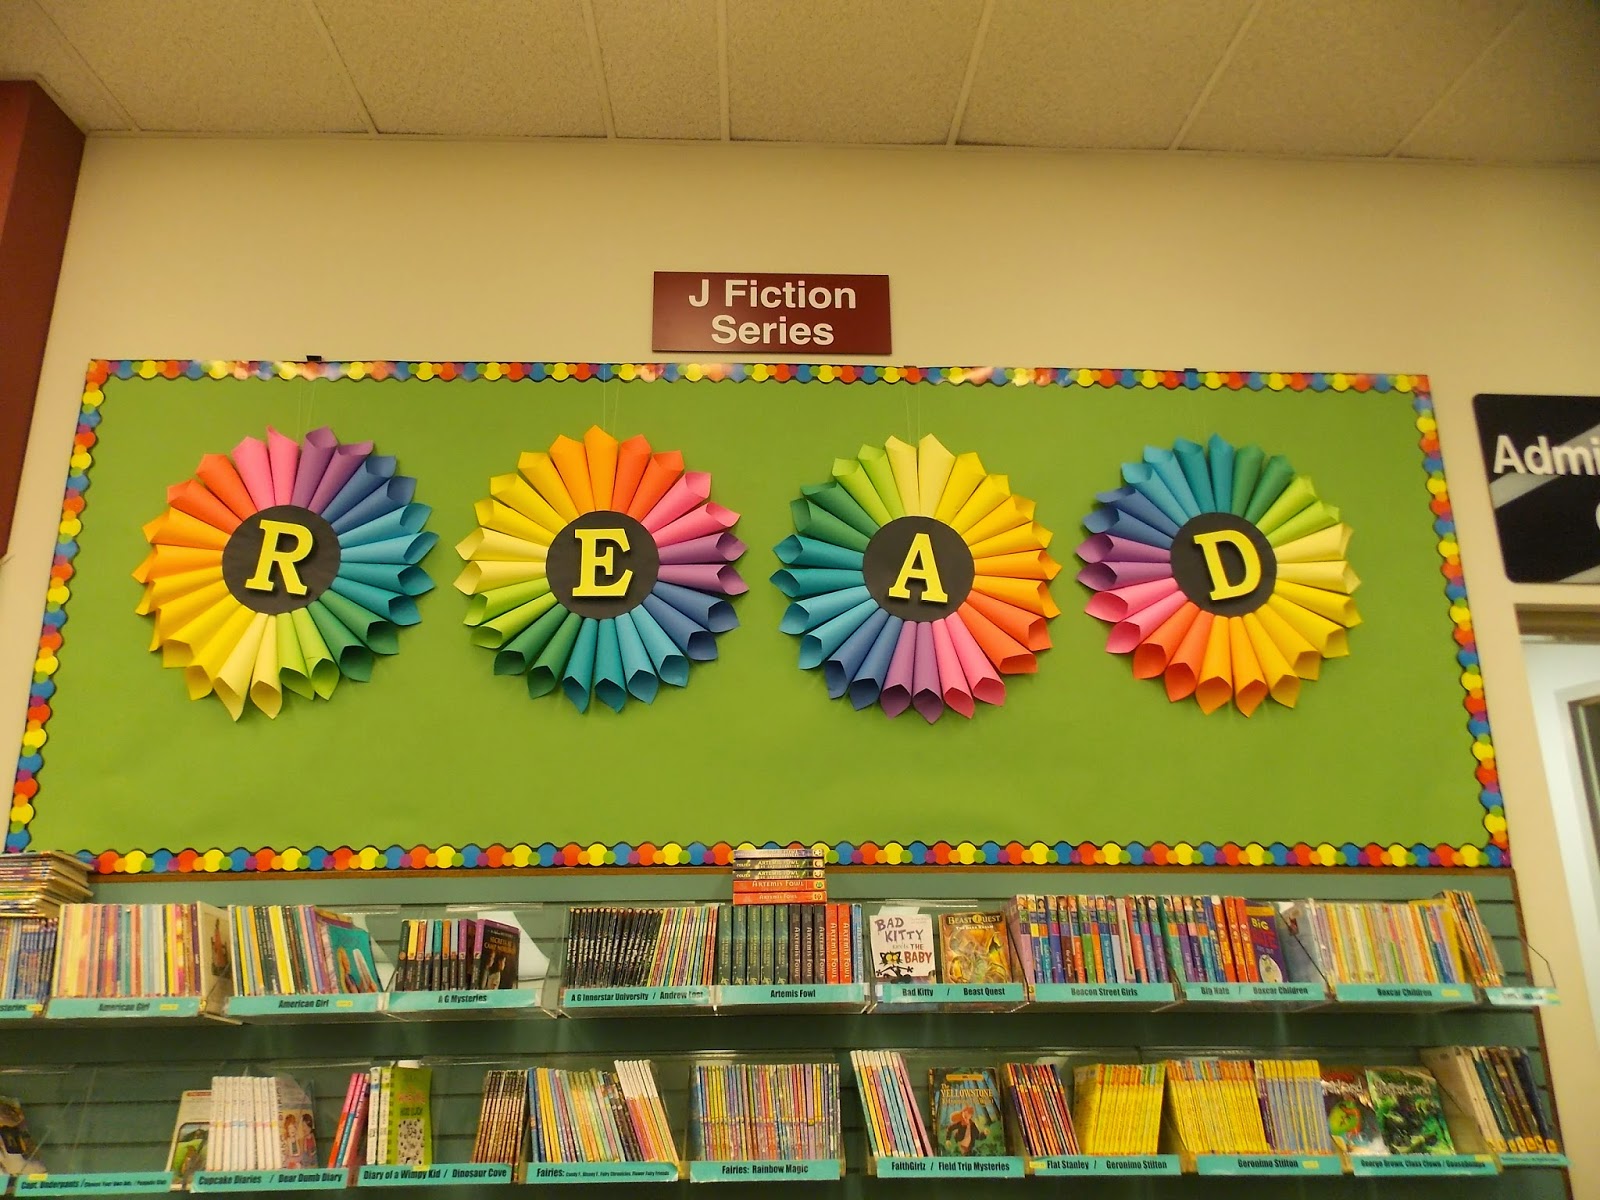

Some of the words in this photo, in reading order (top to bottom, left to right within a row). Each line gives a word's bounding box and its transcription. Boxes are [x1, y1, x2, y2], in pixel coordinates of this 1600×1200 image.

[689, 279, 710, 307] J
[725, 279, 857, 309] Fiction
[711, 314, 834, 345] Series
[1493, 435, 1600, 476] Admi
[245, 519, 314, 597] R
[572, 528, 634, 597] E
[888, 533, 948, 603] A
[1194, 529, 1262, 601] D
[875, 917, 904, 932] BAD
[885, 929, 924, 943] KITTY
[904, 951, 932, 964] BABY
[571, 993, 576, 1002] A
[583, 992, 614, 1001] Innerstar
[614, 991, 649, 1001] University
[660, 990, 687, 999] Andrew
[770, 989, 798, 998] Artemis
[799, 989, 816, 998] Fowl
[902, 988, 916, 997] Bad
[917, 987, 934, 997] Kitty
[963, 987, 983, 996] Beast
[984, 987, 1006, 996] Quest
[1071, 988, 1098, 997] Beacon
[1099, 988, 1120, 996] Street
[1121, 988, 1138, 997] Girls
[1200, 986, 1213, 995] Big
[1278, 986, 1308, 995] Children
[1377, 988, 1401, 997] Boxcar
[1402, 988, 1432, 997] Children
[278, 1000, 314, 1009] American
[315, 999, 329, 1008] Girl
[444, 995, 450, 1003] G
[451, 993, 487, 1004] Mysteries
[98, 1003, 134, 1012] American
[135, 1002, 150, 1012] Girl
[941, 1089, 993, 1097] YELLOWSTONE
[938, 1162, 956, 1171] Field
[957, 1162, 972, 1173] Trip
[973, 1162, 1010, 1173] Mysteries
[1047, 1160, 1060, 1169] Flat
[1062, 1160, 1089, 1170] Stanley
[1106, 1160, 1140, 1169] Geronimo
[1142, 1160, 1167, 1169] Stilton
[1238, 1159, 1272, 1168] Geronimo
[1273, 1159, 1298, 1168] Stilton
[364, 1170, 381, 1181] Diary
[382, 1170, 392, 1179] of
[401, 1169, 427, 1180] Wimpy
[428, 1169, 441, 1178] Kid
[451, 1168, 486, 1178] Dinosaur
[488, 1168, 507, 1177] Cove
[536, 1168, 564, 1177] Fairies:
[722, 1165, 750, 1174] Fairies:
[752, 1165, 784, 1174] Rainbow
[785, 1164, 809, 1175] Magic
[198, 1176, 232, 1186] Cupcake
[234, 1175, 262, 1184] Diaries
[279, 1173, 296, 1183] Dear
[297, 1173, 320, 1182] Dumb
[321, 1172, 342, 1183] Diary
